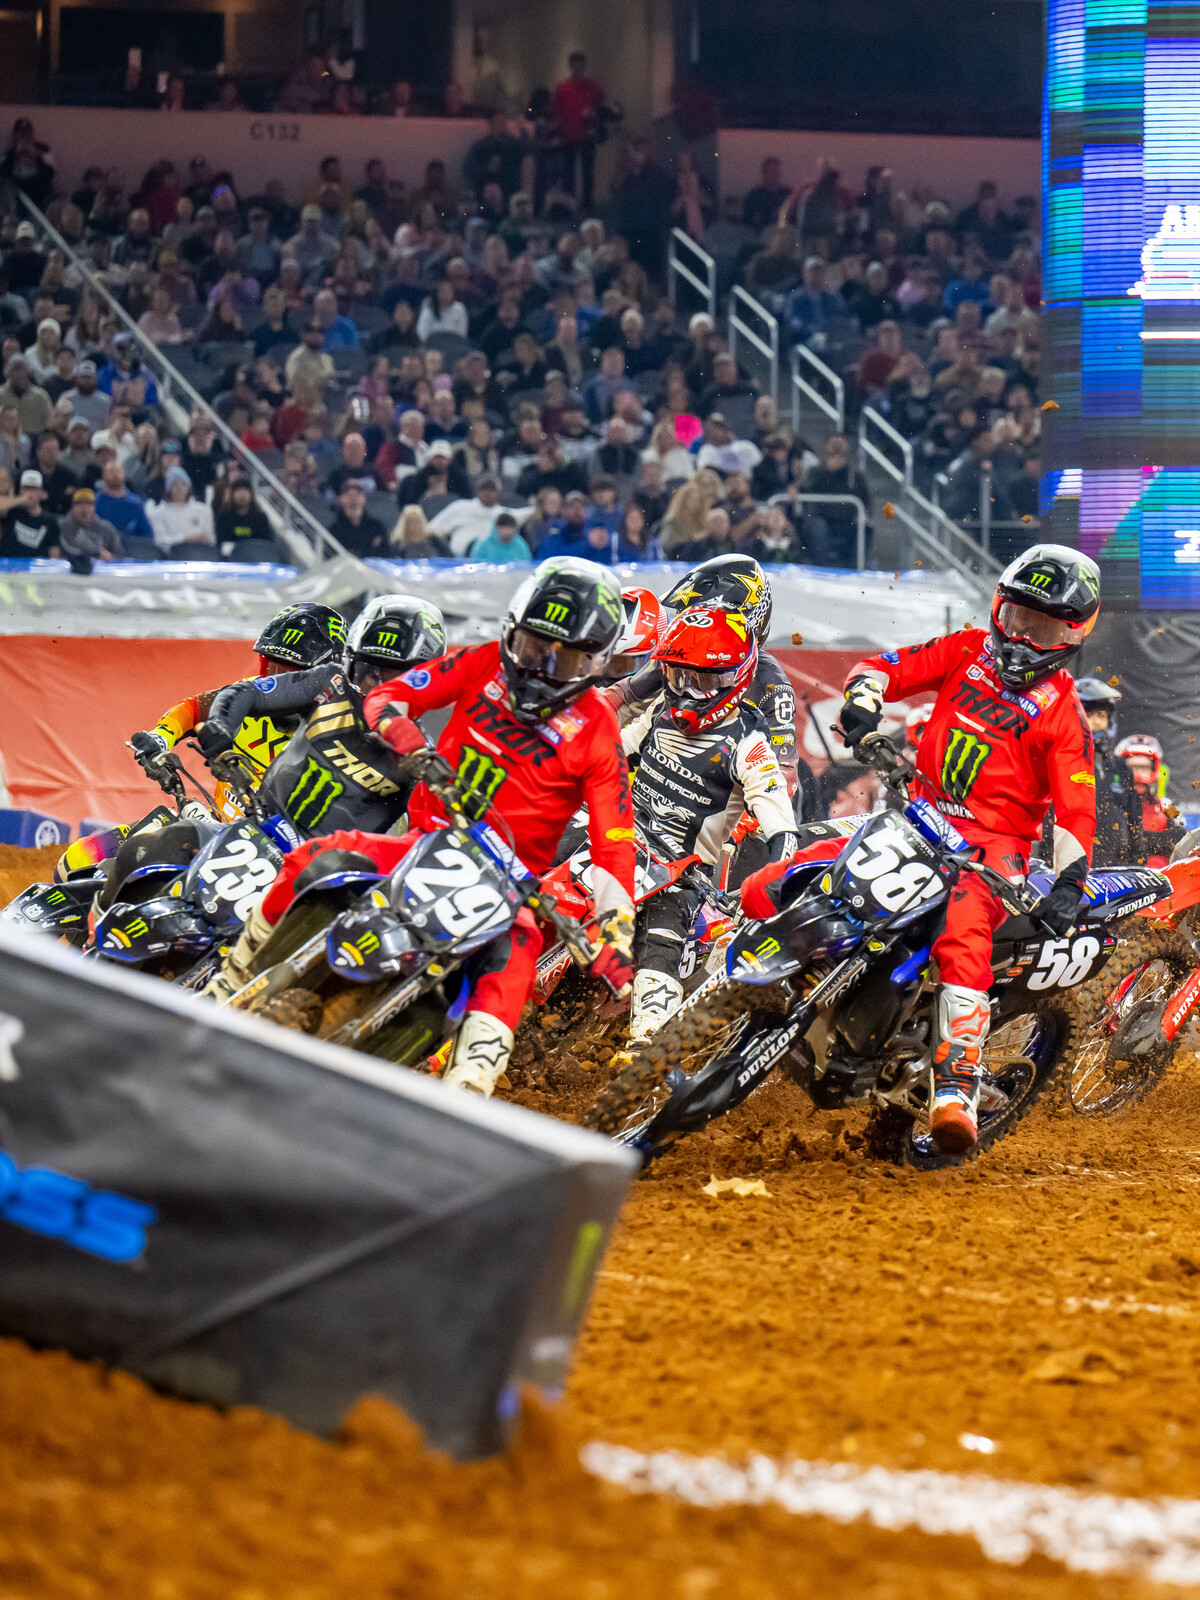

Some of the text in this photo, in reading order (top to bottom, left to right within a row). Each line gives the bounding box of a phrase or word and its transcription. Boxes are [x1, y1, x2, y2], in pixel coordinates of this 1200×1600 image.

[656, 648, 688, 660] dbk.
[466, 693, 557, 767] THOR
[950, 681, 1030, 740] THOR
[322, 740, 400, 797] THOR
[647, 746, 705, 788] HONDA
[664, 779, 713, 806] RACING
[404, 848, 512, 939] 29
[846, 825, 944, 914] 58
[1116, 892, 1157, 919] DUNLOP
[1027, 936, 1101, 991] 58
[737, 1022, 801, 1086] DUNLOP
